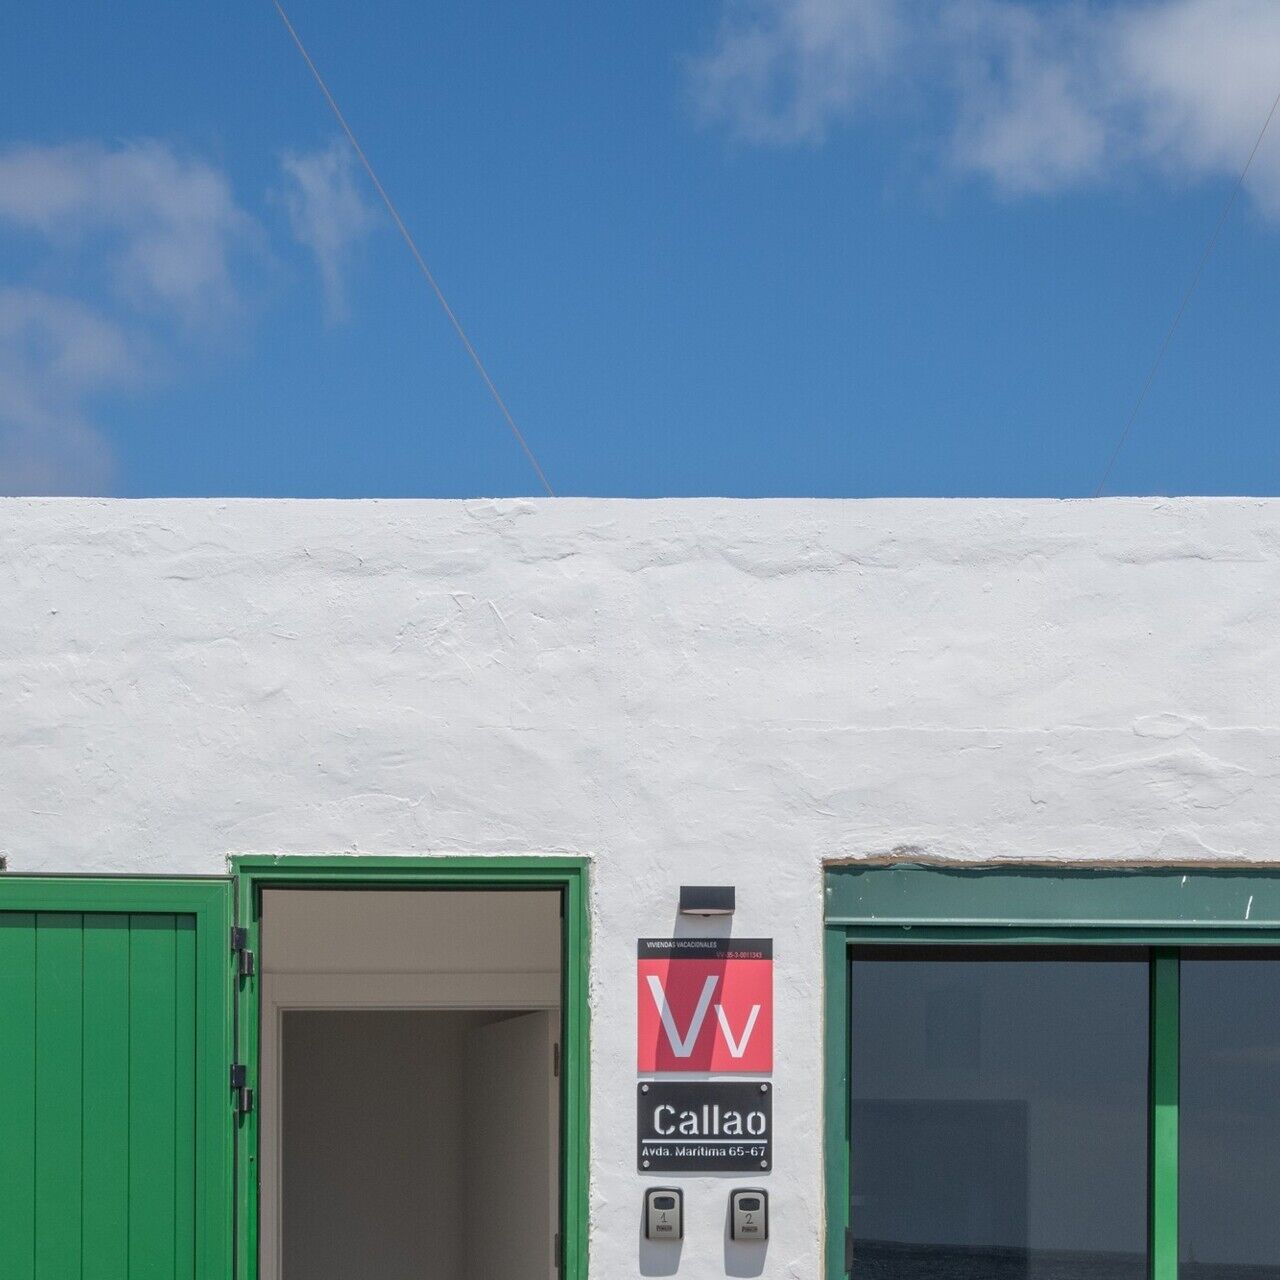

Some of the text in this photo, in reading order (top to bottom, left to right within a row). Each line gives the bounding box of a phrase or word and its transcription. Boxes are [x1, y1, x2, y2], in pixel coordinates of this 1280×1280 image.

[653, 1104, 766, 1135] Callao
[642, 1146, 765, 1156] Avda. Marítima 65-67
[660, 1212, 668, 1223] 1
[745, 1213, 754, 1224] 2
